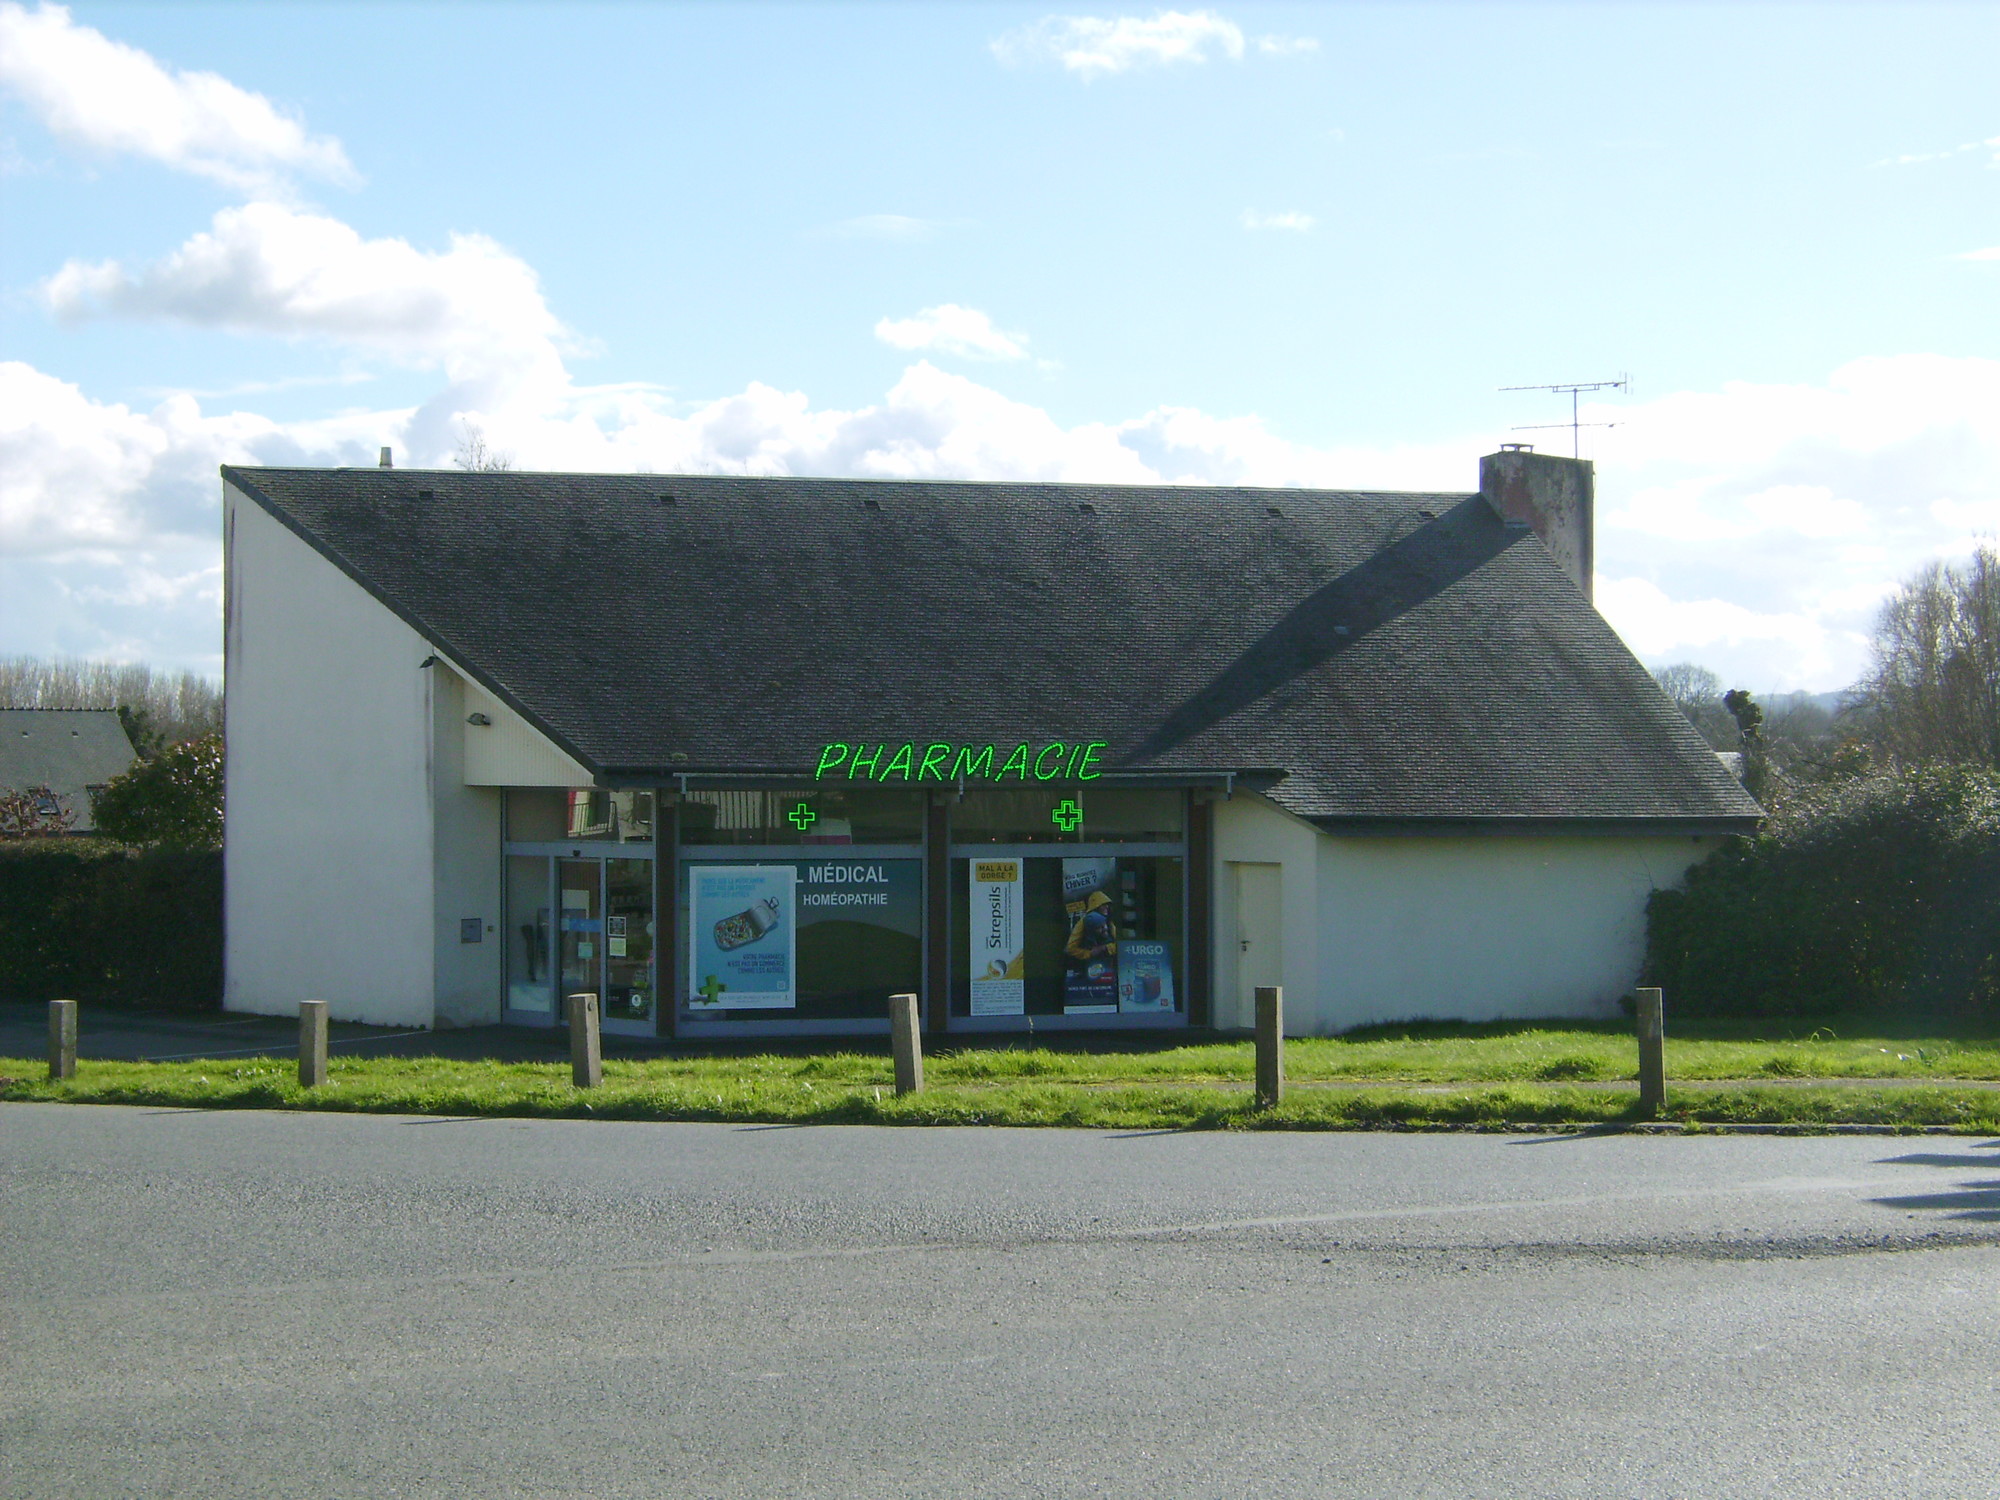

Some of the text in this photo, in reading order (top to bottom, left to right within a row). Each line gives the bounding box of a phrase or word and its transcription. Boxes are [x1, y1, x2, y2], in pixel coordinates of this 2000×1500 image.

[815, 741, 1109, 783] PHARMACIE
[809, 862, 889, 883] MÉDICAL
[1092, 875, 1097, 883] ?
[803, 891, 888, 906] HOMÉOPATHIE
[989, 886, 1004, 949] Strepsils
[1131, 945, 1164, 955] URGO
